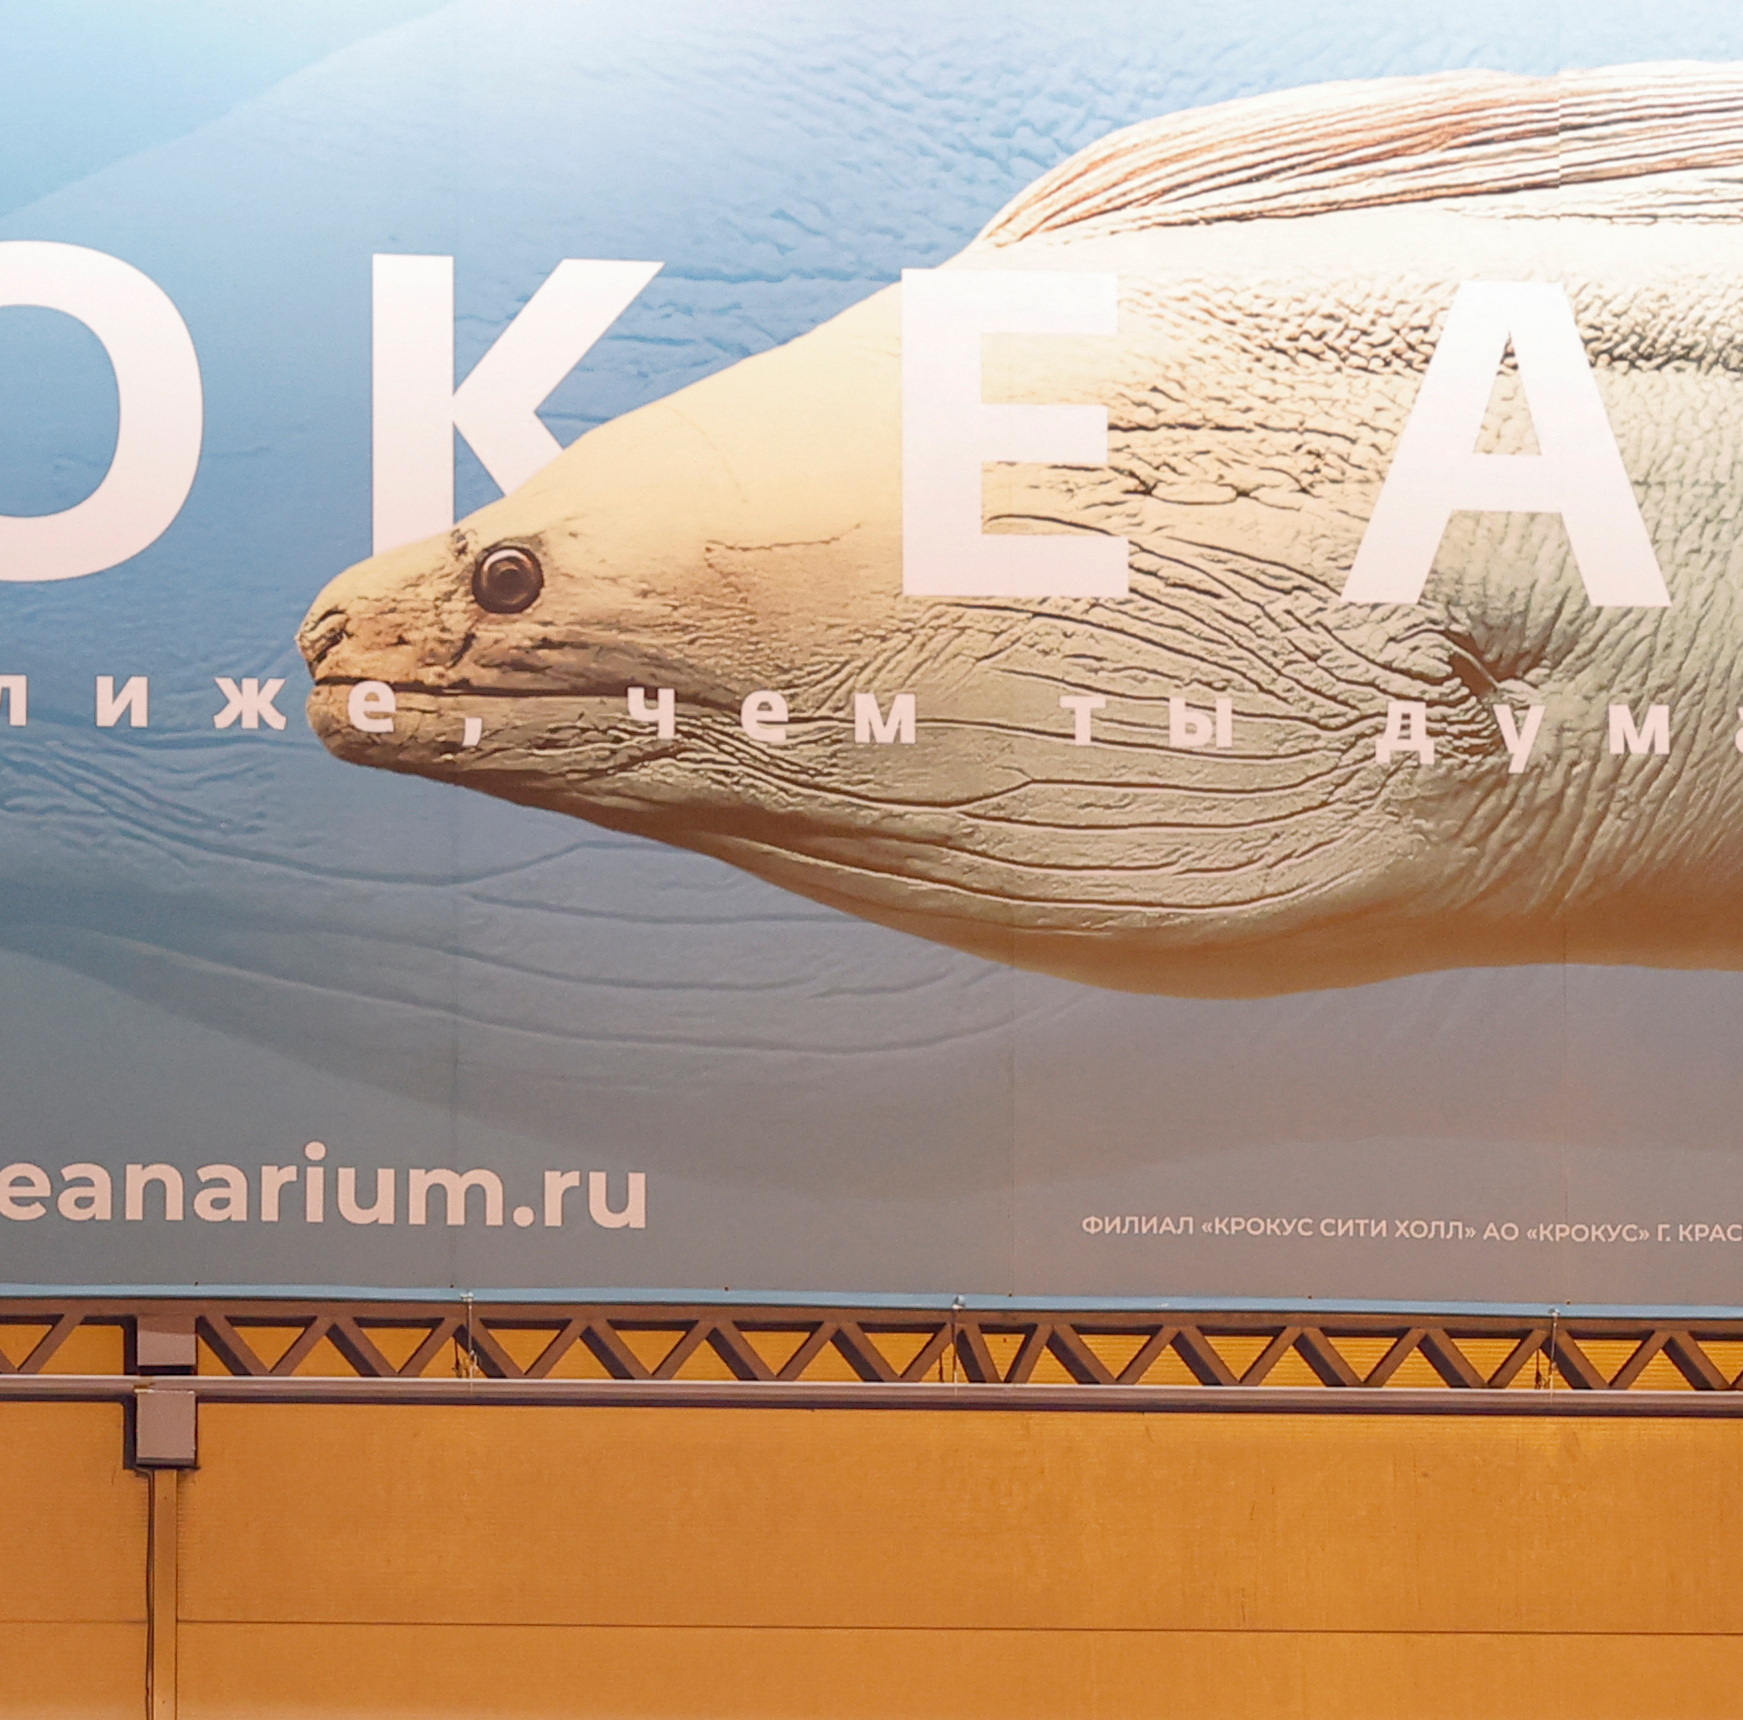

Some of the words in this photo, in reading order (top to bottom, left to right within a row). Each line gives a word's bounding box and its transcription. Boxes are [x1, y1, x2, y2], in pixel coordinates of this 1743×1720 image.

[628, 683, 918, 745] чем
[1058, 695, 1235, 748] ты
[1081, 1215, 1194, 1235] ФИЛИАЛ
[1201, 1216, 1314, 1237] «КРОКУС
[1319, 1217, 1387, 1238] СИТИ
[1394, 1219, 1477, 1240] ХОЛЛ»
[1482, 1222, 1520, 1241] АО
[1526, 1223, 1650, 1243] «КРОКУС»
[1657, 1223, 1672, 1242] Г.
